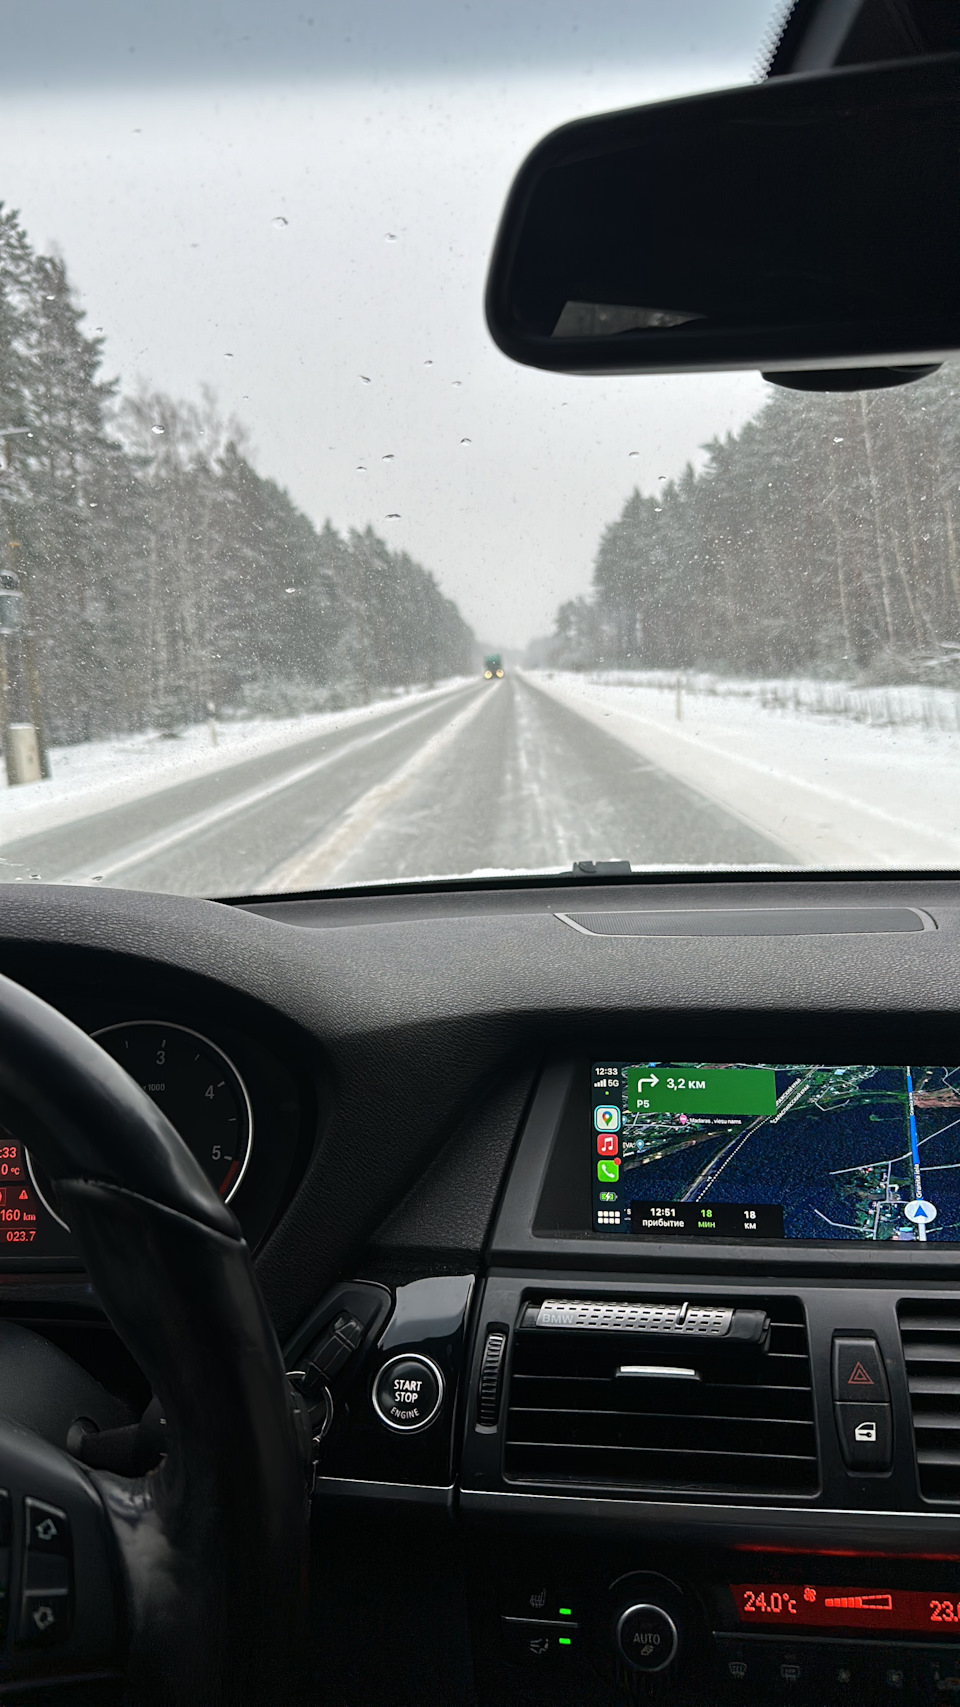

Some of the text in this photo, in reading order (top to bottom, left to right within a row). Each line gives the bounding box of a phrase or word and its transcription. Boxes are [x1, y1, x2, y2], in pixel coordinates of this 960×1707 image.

[156, 1050, 165, 1065] 3
[666, 1078, 686, 1091] 3,2
[205, 1084, 215, 1100] 4
[636, 1099, 650, 1109] P5
[212, 1145, 221, 1161] 5
[23, 1213, 36, 1221] km
[650, 1208, 676, 1217] 12:51
[701, 1209, 713, 1218] 18
[744, 1211, 757, 1219] 18
[642, 1219, 685, 1228] прибытие
[6, 1231, 36, 1242] 023.7
[542, 1313, 574, 1324] BMW
[393, 1379, 422, 1391] START
[394, 1391, 419, 1403] STOP
[390, 1406, 420, 1419] ENGINE
[929, 1600, 960, 1623] 23.
[632, 1633, 660, 1645] AUTO
